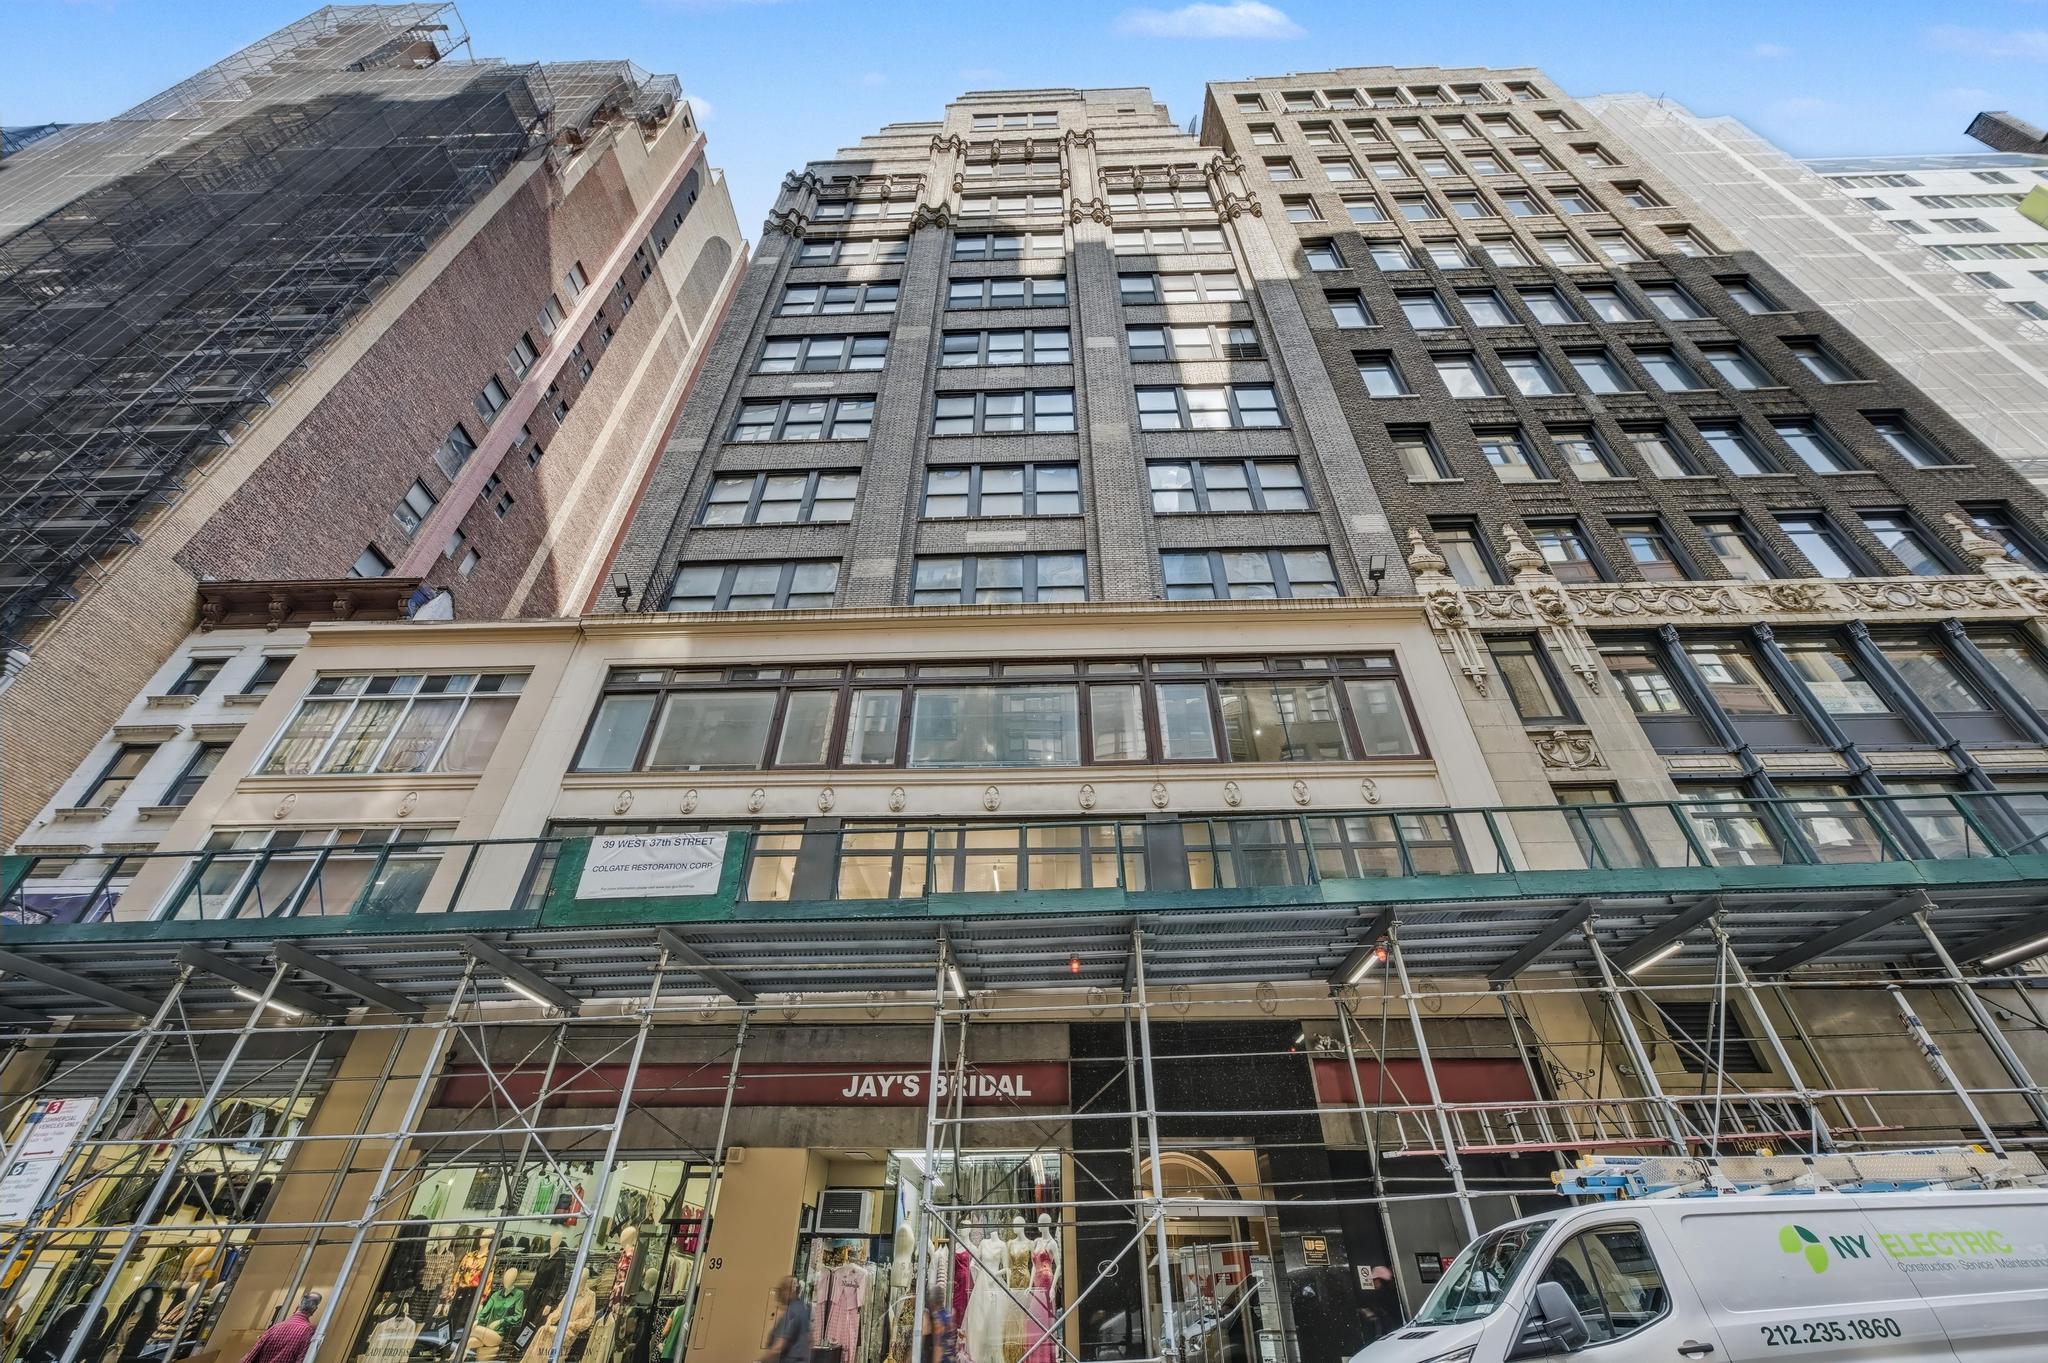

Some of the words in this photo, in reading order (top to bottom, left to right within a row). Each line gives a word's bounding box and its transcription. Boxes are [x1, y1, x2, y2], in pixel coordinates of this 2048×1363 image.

[603, 840, 615, 849] 39
[618, 839, 647, 848] WEST
[649, 838, 671, 847] 37th
[674, 837, 715, 846] STREET
[592, 864, 630, 873] COLGATE
[631, 862, 688, 871] RESTORATION
[689, 862, 714, 870] CORP.
[842, 1075, 920, 1097] JAY'S
[936, 1075, 1032, 1097] BRIDAL
[48, 1101, 61, 1114] 3
[12, 1162, 25, 1176] 6
[1829, 1235, 1871, 1259] NY
[1877, 1230, 2013, 1258] ELECTRIC
[709, 1257, 723, 1270] 39
[1898, 1261, 1956, 1273] Construction
[1959, 1259, 1994, 1271] Service
[1760, 1317, 1902, 1347] 212.235.1860
